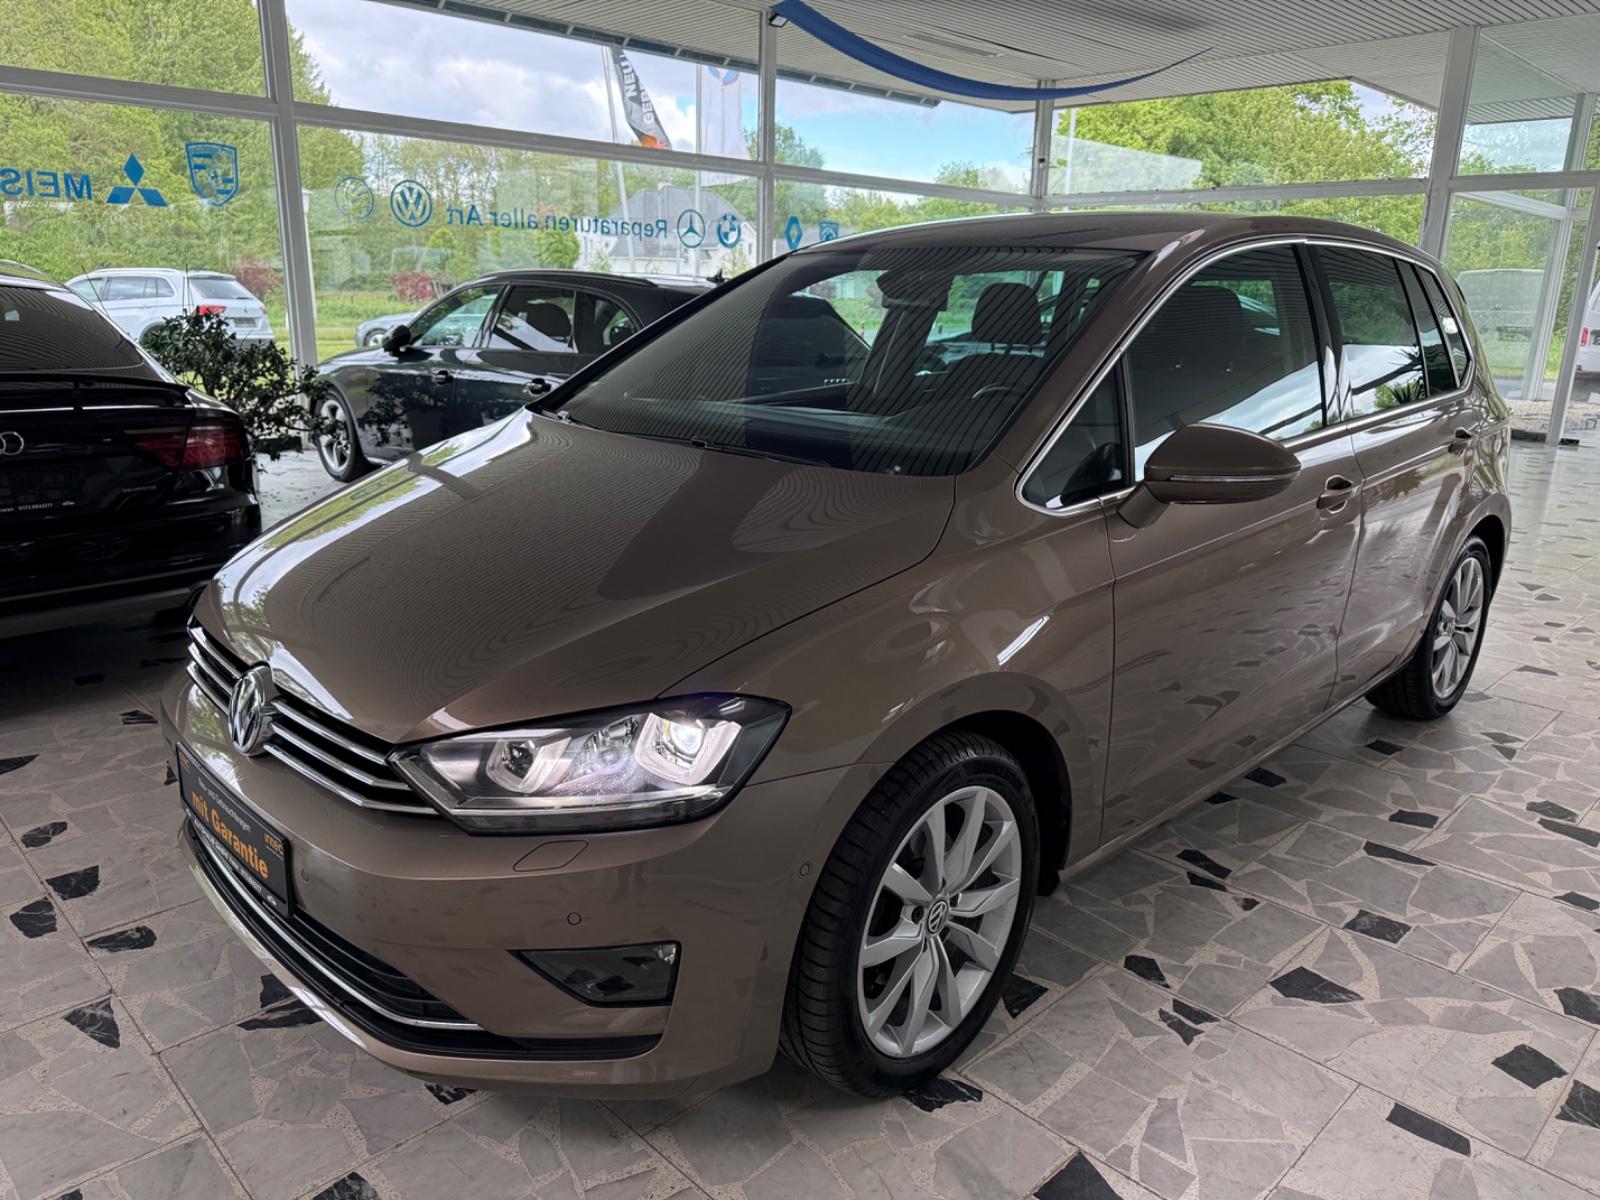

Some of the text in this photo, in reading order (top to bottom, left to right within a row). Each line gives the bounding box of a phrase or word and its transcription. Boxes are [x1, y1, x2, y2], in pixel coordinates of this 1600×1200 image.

[640, 83, 655, 124] GEB
[192, 790, 209, 822] mit
[211, 808, 269, 879] Garantie
